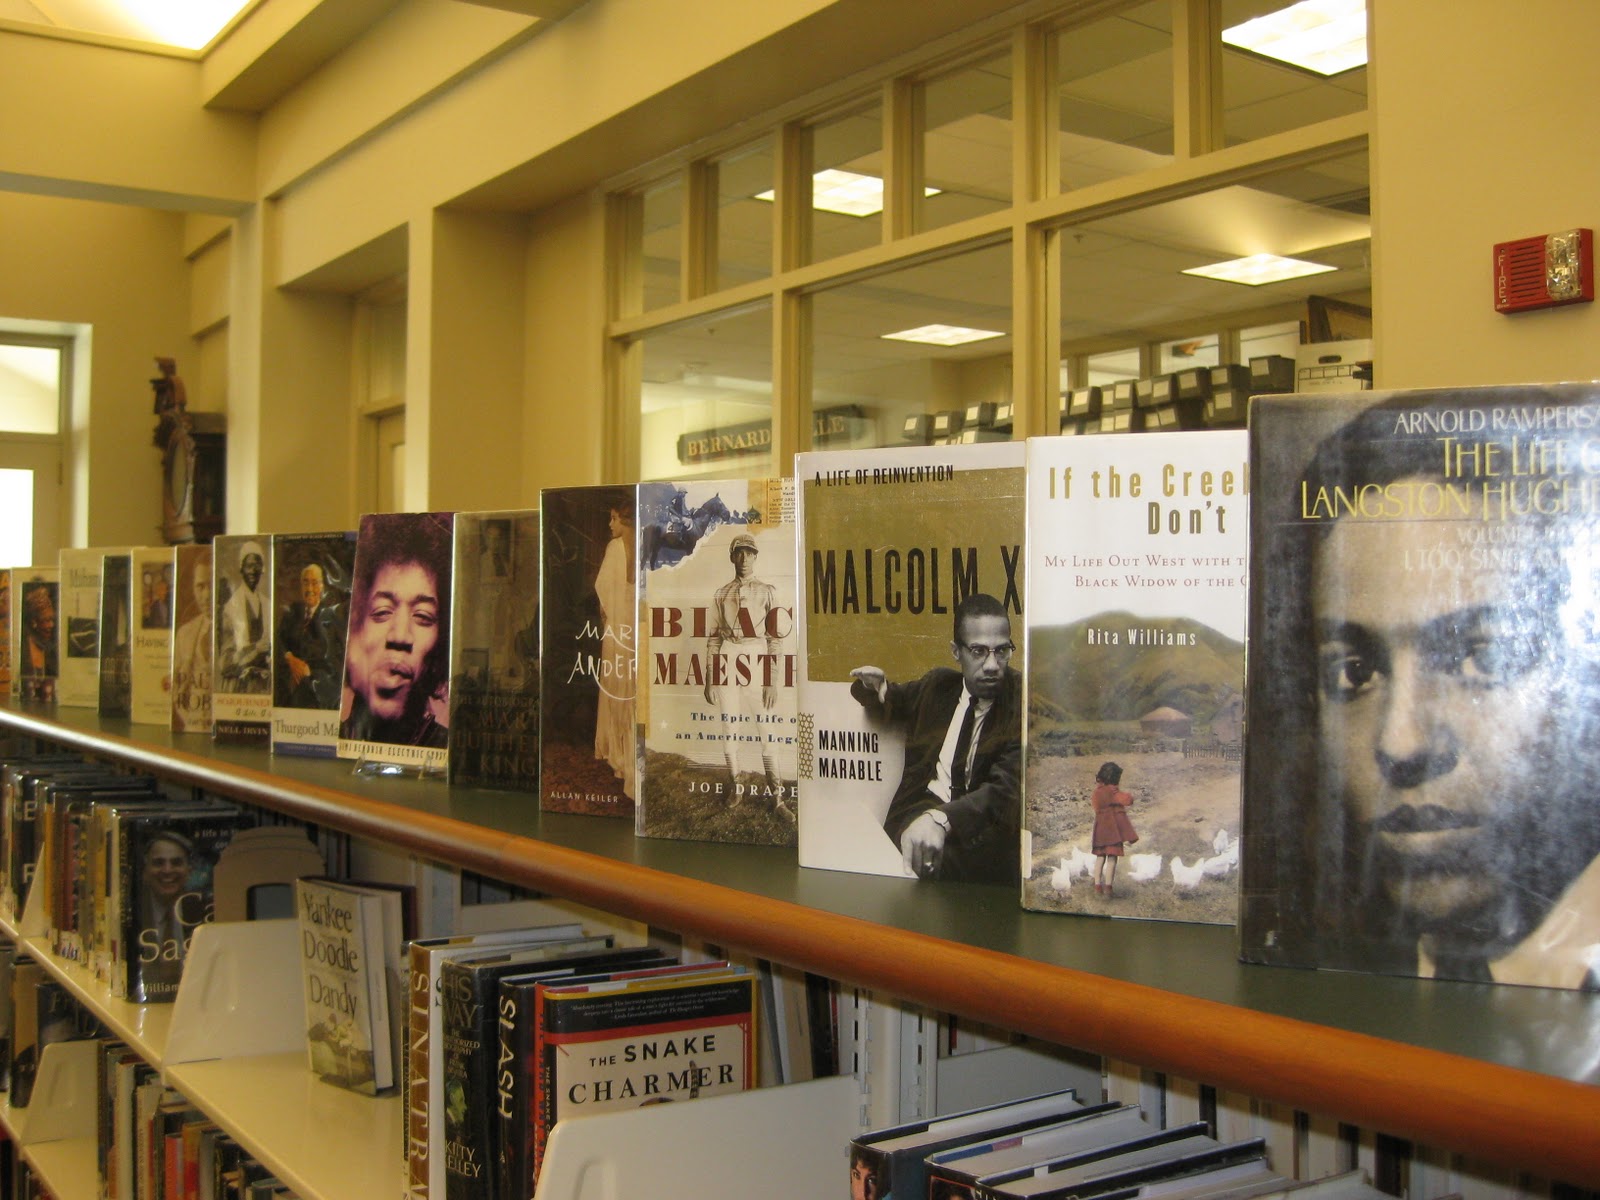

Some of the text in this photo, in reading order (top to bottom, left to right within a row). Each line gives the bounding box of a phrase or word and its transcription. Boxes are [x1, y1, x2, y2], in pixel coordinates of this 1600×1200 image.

[1498, 255, 1506, 298] FIRE
[1394, 409, 1486, 434] ARNOLD
[1436, 437, 1501, 478] THE
[1512, 435, 1572, 477] LIFE
[815, 464, 954, 487] A LIFE OF REINVENTION
[1050, 467, 1072, 499] If
[1091, 465, 1142, 498] the
[1302, 481, 1472, 519] LANGSTON
[1148, 501, 1226, 535] Don't
[1192, 557, 1230, 567] WITH
[813, 545, 1022, 615] MALCOLM X
[1075, 575, 1119, 588] BLACK
[1125, 575, 1178, 588] WIDOW
[1184, 578, 1200, 588] OF
[1207, 577, 1235, 588] THE
[1087, 629, 1196, 646] Rita Williams
[275, 719, 320, 738] Thurgood
[690, 712, 715, 721] The
[721, 713, 750, 724] Epic
[756, 714, 784, 724] Life
[675, 732, 691, 740] an
[696, 731, 762, 742] American
[819, 729, 882, 781] MANNING MARABLE
[550, 791, 619, 804] ALLAN KEILER
[689, 781, 798, 798] JOE DRAPE
[303, 893, 353, 933] Yankee
[303, 930, 359, 973] Doodle
[308, 974, 358, 1018] Dandy
[498, 994, 517, 1120] SLASH
[589, 1034, 716, 1068] THE SNAKE
[411, 970, 429, 1190] SINATRA
[568, 1063, 734, 1105] CHARMER
[446, 1154, 482, 1178] ELLEY
